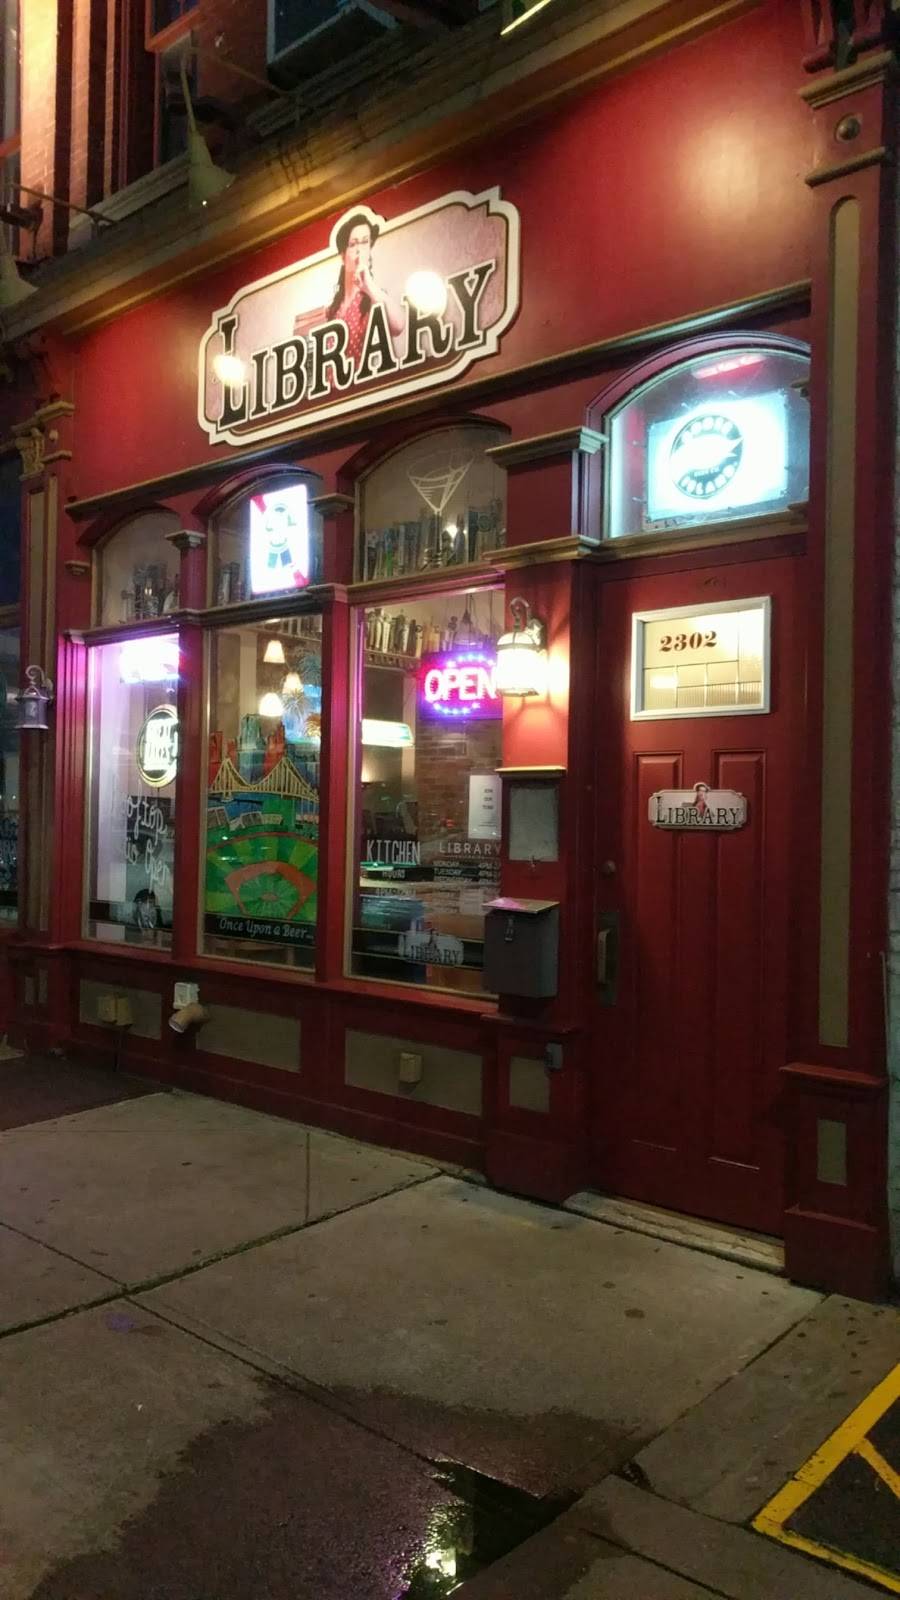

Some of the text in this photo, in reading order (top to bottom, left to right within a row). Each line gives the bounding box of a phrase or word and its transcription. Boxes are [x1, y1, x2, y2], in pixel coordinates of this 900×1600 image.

[216, 258, 497, 430] LIBRARY
[659, 630, 718, 652] 2302
[424, 667, 498, 702] OPEN
[655, 796, 740, 825] LIBRARY
[366, 839, 421, 866] KITCHEN
[245, 920, 272, 937] Upon
